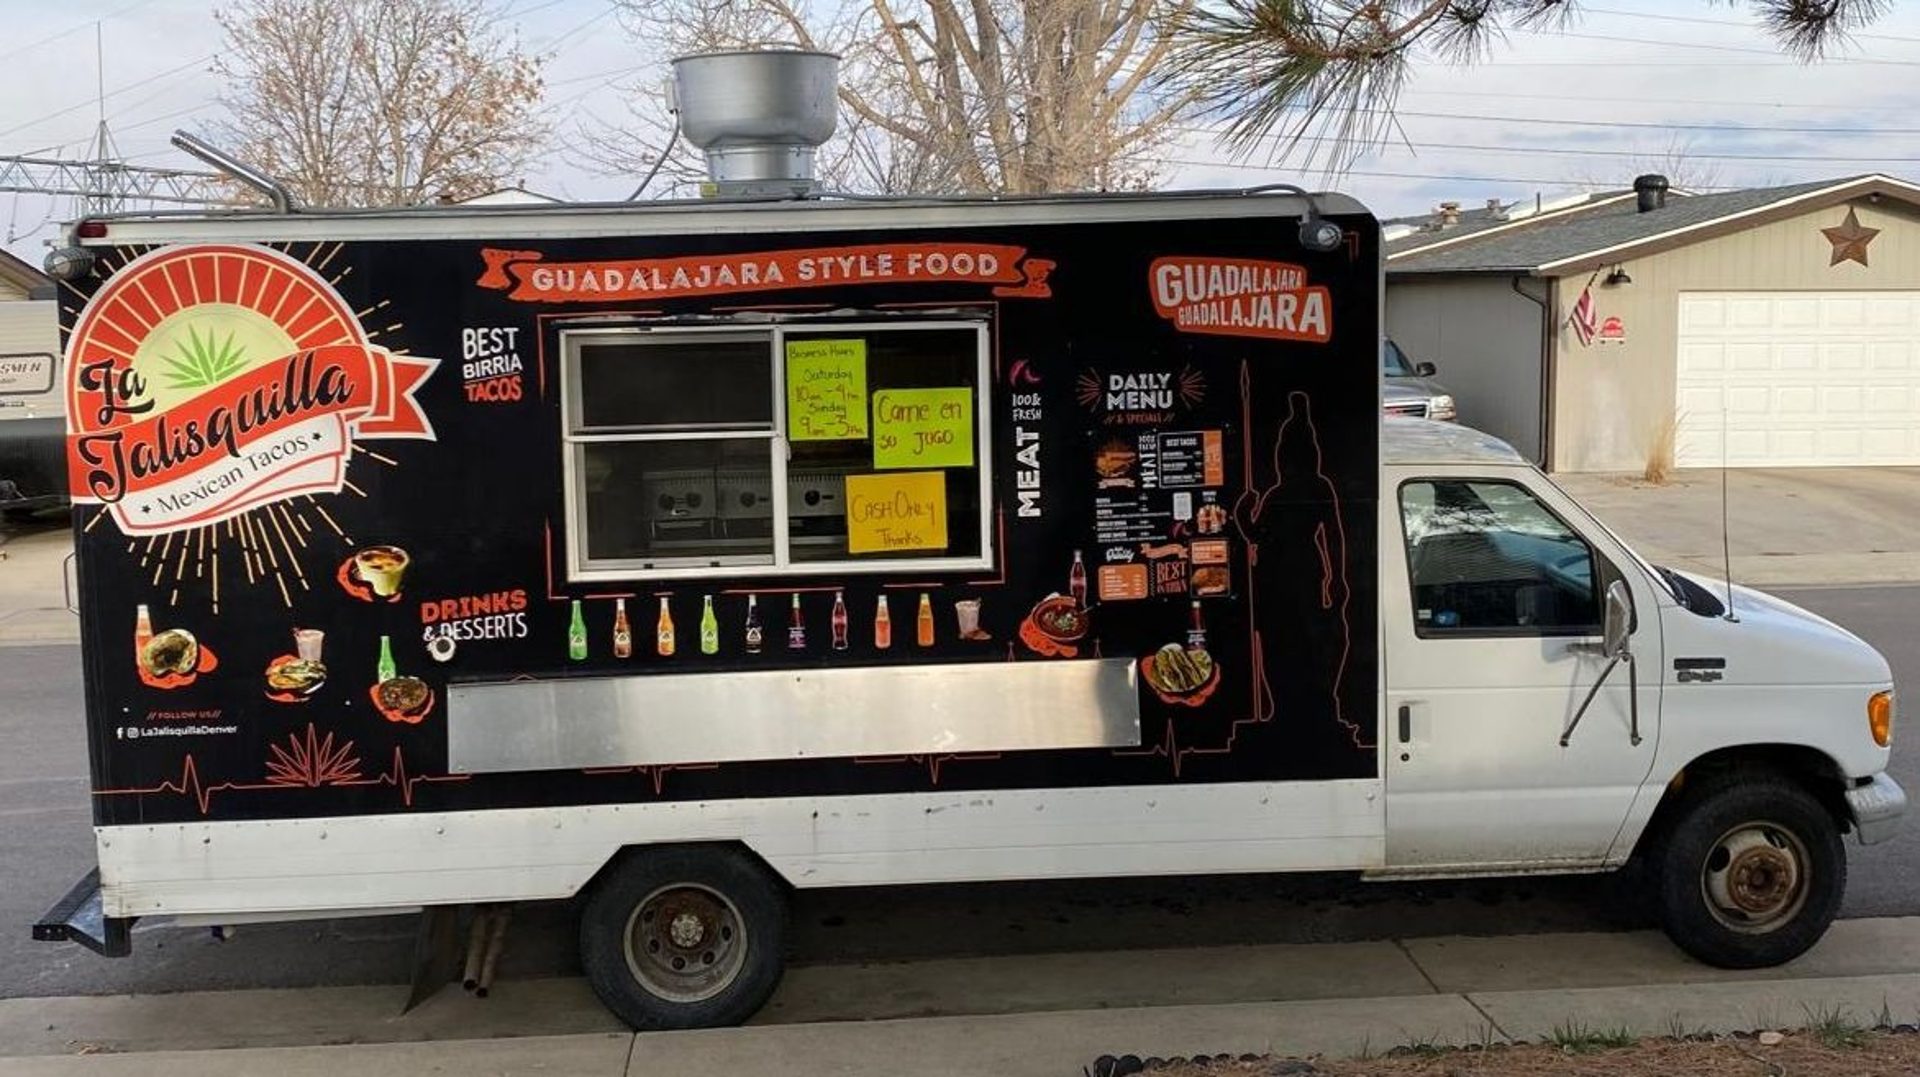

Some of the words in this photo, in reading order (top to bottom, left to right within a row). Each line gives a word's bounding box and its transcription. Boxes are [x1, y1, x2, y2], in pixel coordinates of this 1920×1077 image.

[532, 262, 785, 292] GUADALAJARA
[798, 254, 893, 281] STYLE
[907, 252, 998, 276] FOOD
[1156, 264, 1301, 307] GUADALAJARA
[1178, 291, 1326, 335] GUADALAJARA
[462, 327, 519, 360] BEST
[462, 353, 523, 380] BIRRIA
[803, 366, 854, 387] Saturday
[79, 358, 155, 426] La
[463, 376, 523, 402] TACOS
[1109, 373, 1172, 391] DAILY
[940, 402, 962, 420] en
[1012, 407, 1042, 422] FRESH
[1106, 390, 1173, 411] MENU
[78, 350, 356, 504] Jalisquilla
[156, 466, 244, 515] Mexican
[242, 434, 309, 474] Tacos
[1016, 426, 1042, 518] MEAT
[874, 527, 924, 546] Thanks
[421, 589, 528, 624] DRINKS
[422, 625, 436, 642] &
[439, 612, 528, 641] DESSERTS
[141, 725, 238, 737] LaJalisquillaDenver
